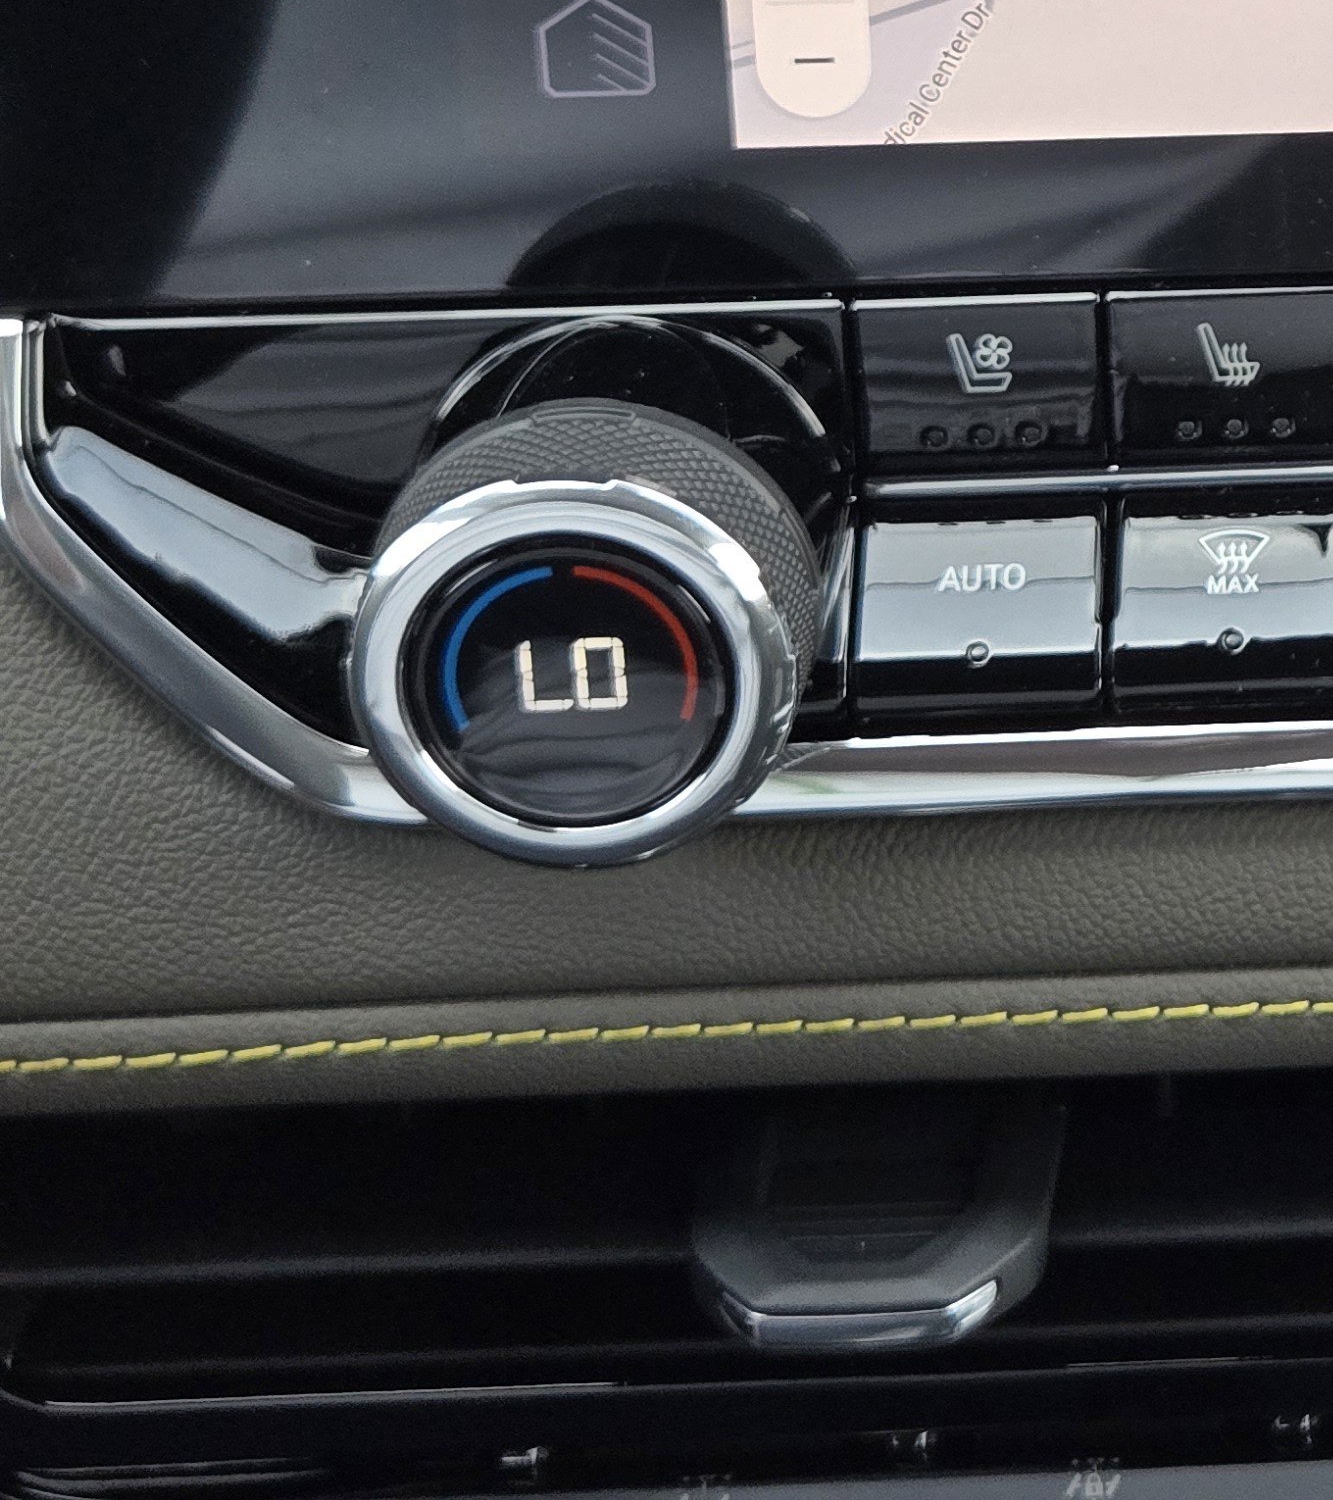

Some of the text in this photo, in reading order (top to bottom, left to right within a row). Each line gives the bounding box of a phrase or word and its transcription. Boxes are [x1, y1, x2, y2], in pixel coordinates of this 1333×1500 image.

[884, 3, 989, 145] dical Center Dr
[937, 561, 1027, 592] AUTO
[1206, 574, 1258, 594] MAX
[515, 637, 628, 712] LO
